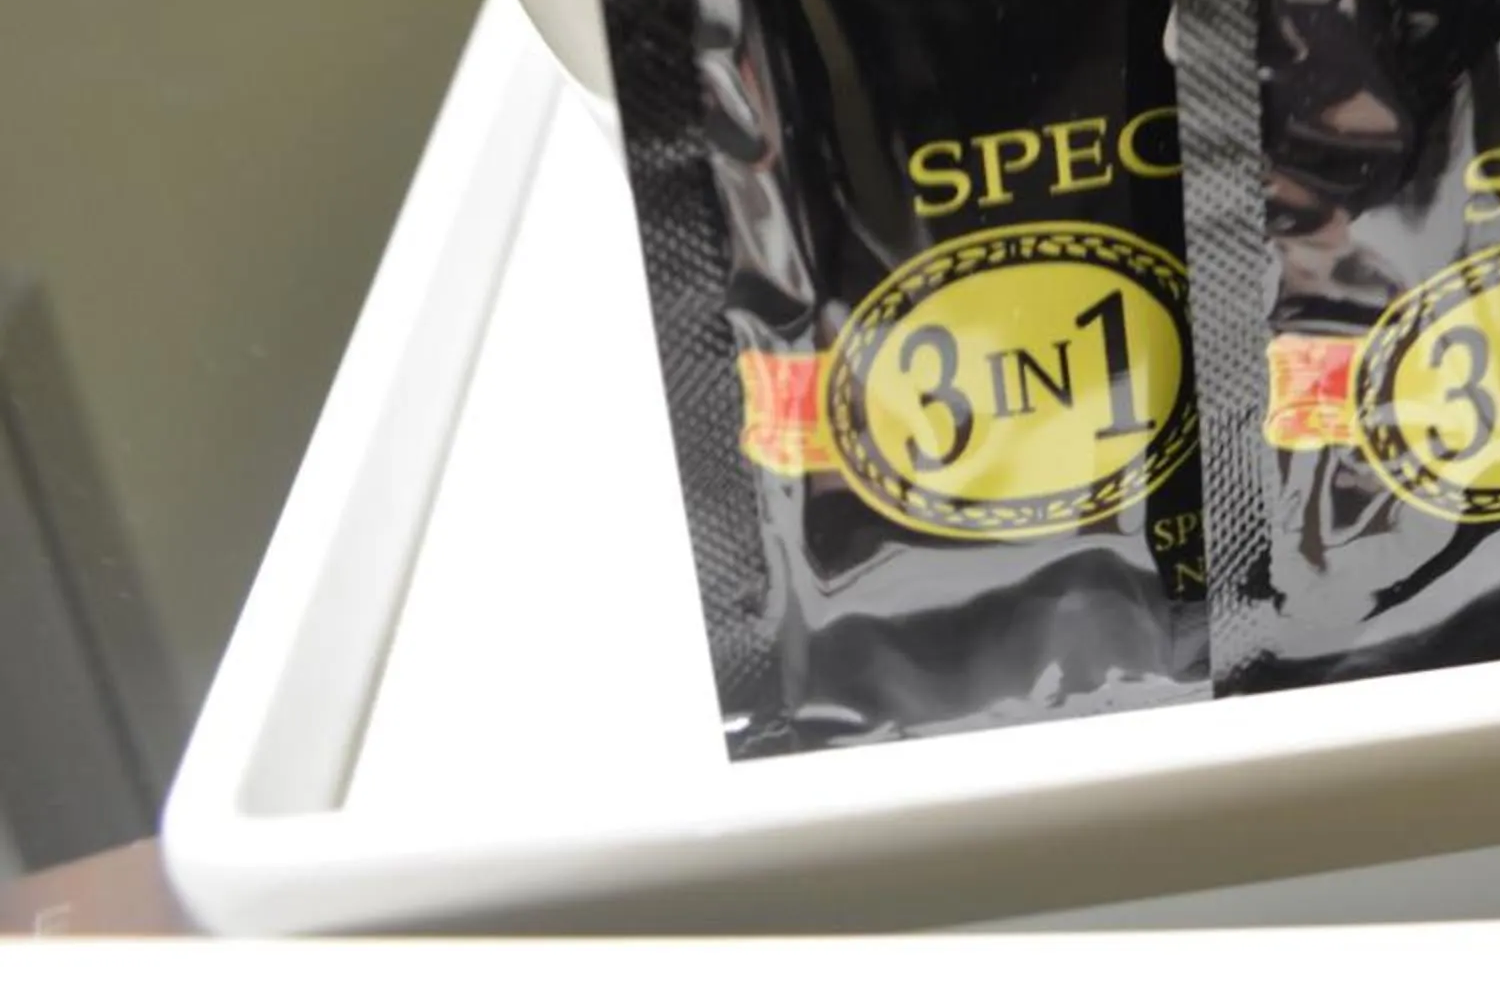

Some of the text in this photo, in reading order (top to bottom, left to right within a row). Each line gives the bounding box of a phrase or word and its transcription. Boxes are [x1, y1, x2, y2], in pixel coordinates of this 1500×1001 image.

[899, 288, 1157, 474] 3 IN 1
[1424, 324, 1498, 464] 3
